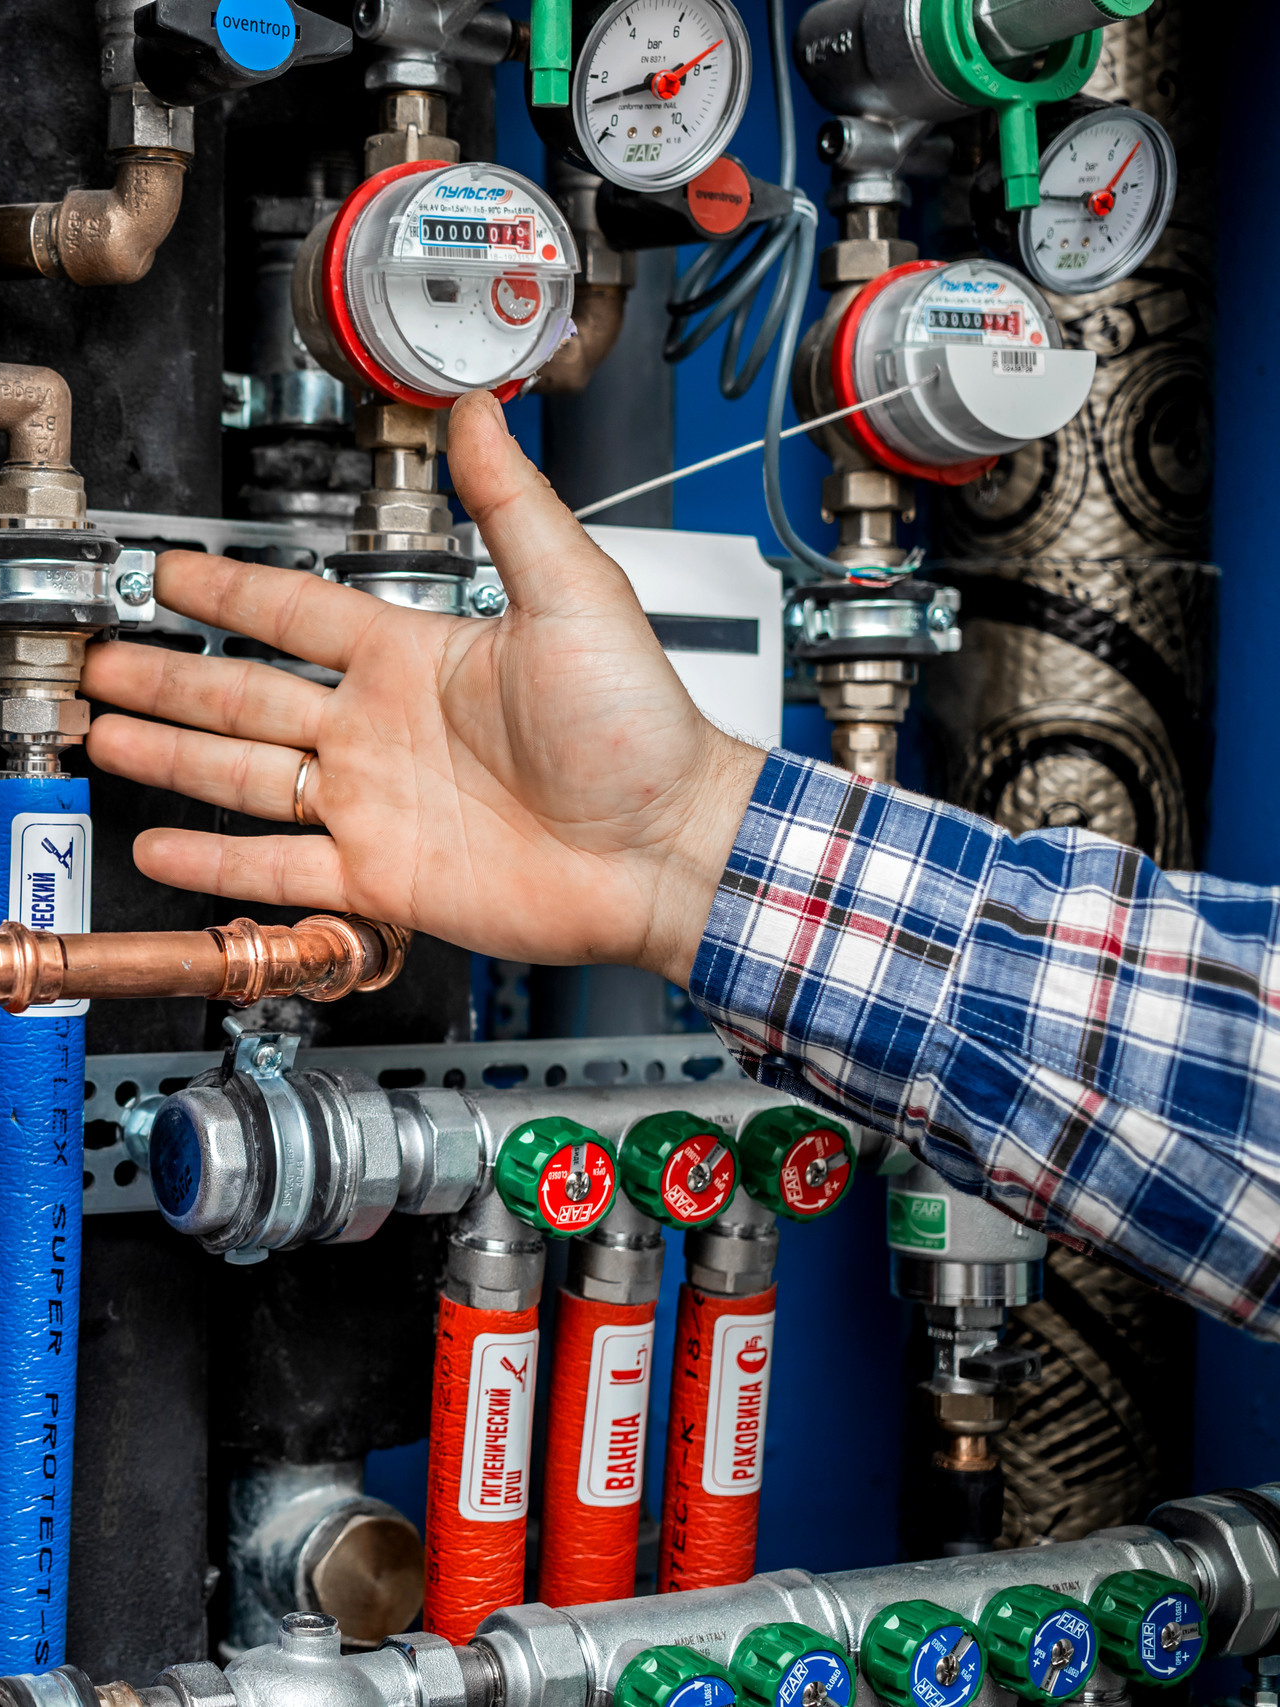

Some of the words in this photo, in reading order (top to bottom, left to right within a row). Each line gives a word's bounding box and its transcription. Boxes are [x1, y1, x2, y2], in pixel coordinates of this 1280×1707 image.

[222, 15, 290, 40] oventrop
[629, 27, 637, 40] 4
[673, 25, 680, 38] 6
[647, 38, 663, 50] bar
[601, 71, 609, 84] 2
[694, 64, 701, 77] 8
[611, 114, 618, 127] 0
[671, 112, 682, 125] 10
[623, 143, 663, 162] FAR
[435, 185, 506, 201] ПУЛЬСАР
[547, 1170, 569, 1180] CLOSED
[593, 1166, 606, 1176] OPEN
[784, 1167, 802, 1202] FAR
[665, 1186, 697, 1217] FAR
[910, 1200, 943, 1217] FAR
[557, 1204, 593, 1224] FAR
[47, 1203, 66, 1356] SUPER
[732, 1379, 764, 1482] РАКОВИНА
[480, 1387, 512, 1507] ГИГИЕНИЧЕСКИЙ
[604, 1412, 642, 1492] ВАННА
[503, 1468, 523, 1505] ДУШ
[35, 1392, 59, 1666] PROTECT-S
[1060, 1580, 1081, 1592] ITALY
[1058, 1613, 1087, 1638] FAR
[674, 1635, 696, 1647] MADE
[696, 1634, 704, 1644] IN
[706, 1630, 727, 1643] ITALY
[931, 1638, 947, 1656] CLOSED
[1143, 1624, 1155, 1659] FAR
[1034, 1647, 1047, 1660] OPEN
[780, 1661, 807, 1702] FAR
[825, 1668, 841, 1691] CLOSED
[704, 1683, 713, 1707] CLOSED
[916, 1679, 945, 1707] FAR
